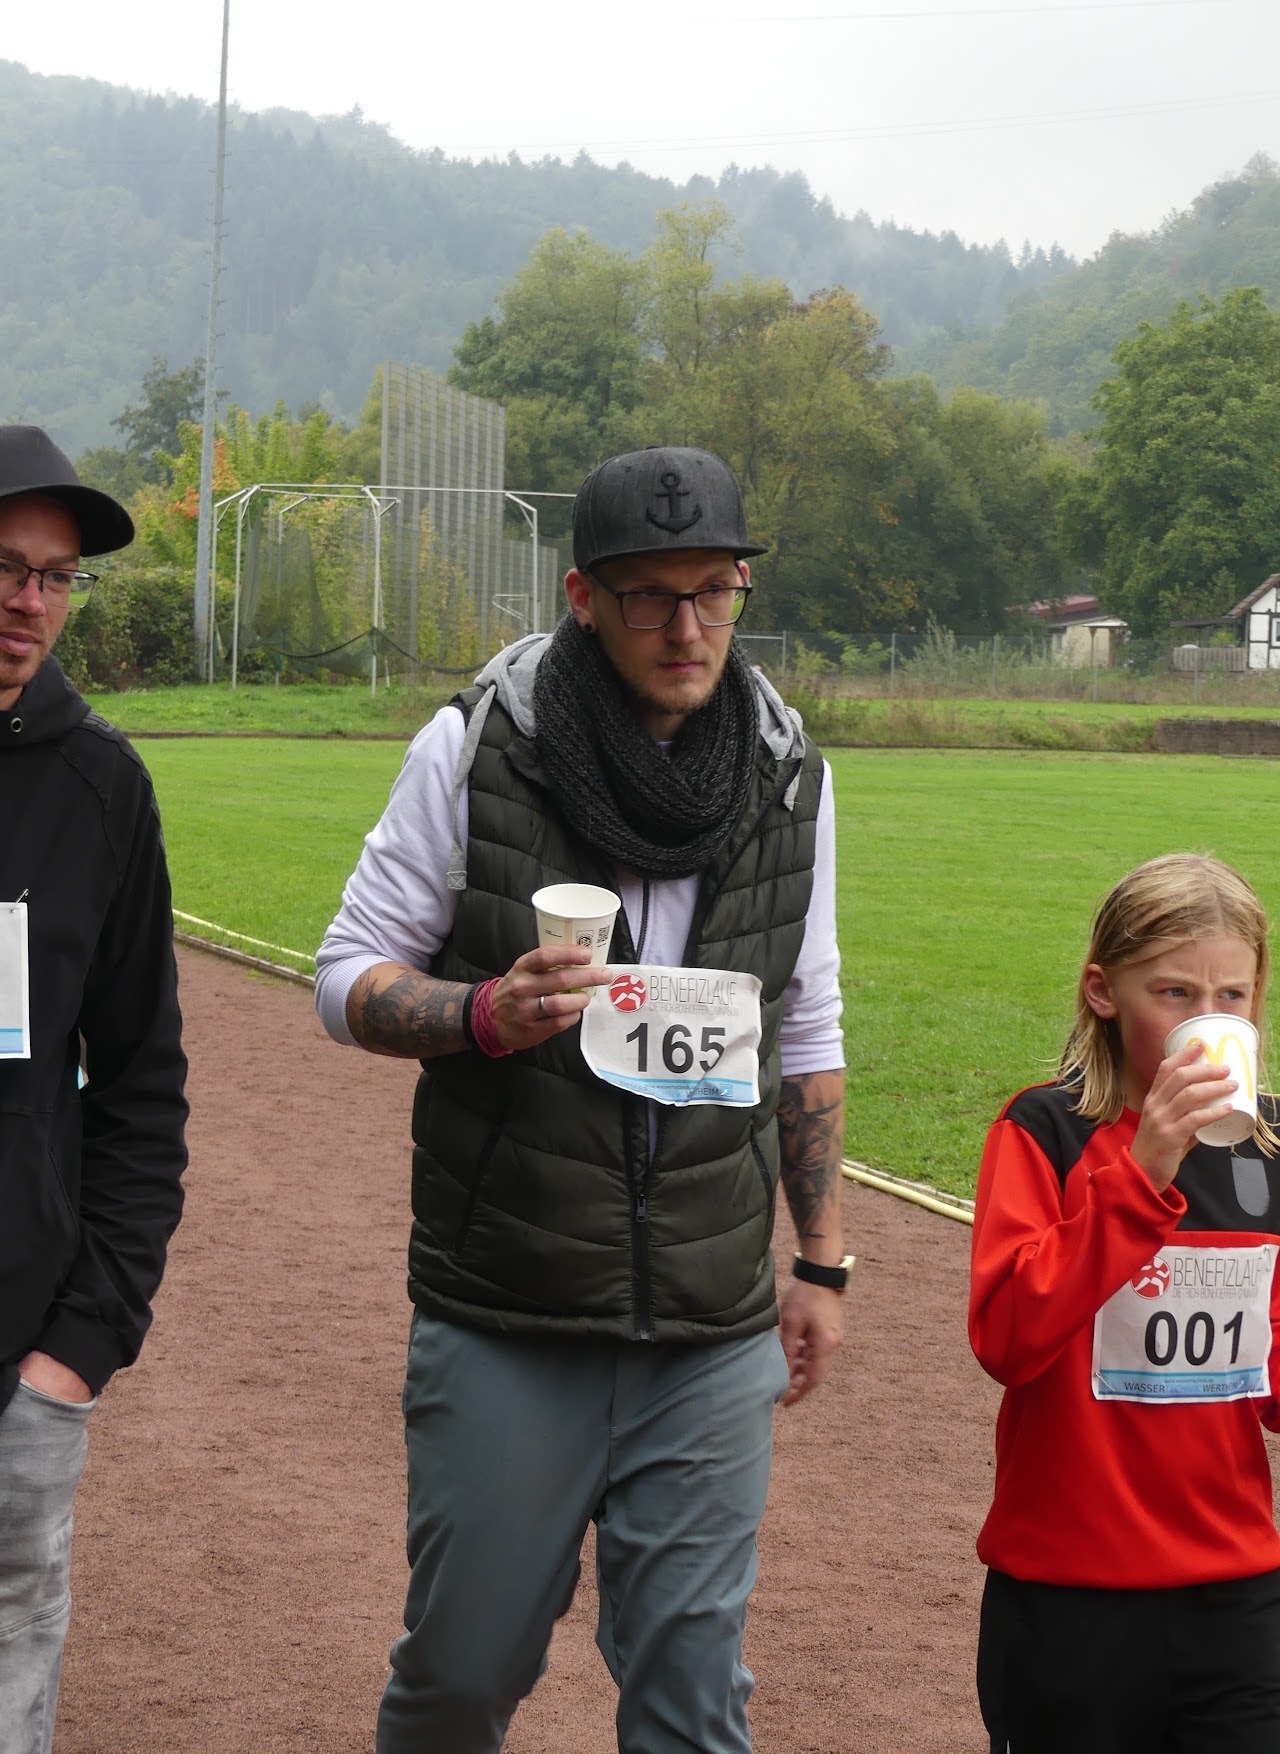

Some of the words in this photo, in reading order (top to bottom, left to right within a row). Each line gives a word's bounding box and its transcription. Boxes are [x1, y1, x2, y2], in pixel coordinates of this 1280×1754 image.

[650, 975, 737, 1005] BENEFIZLAUF
[625, 1022, 725, 1074] 165
[1144, 1310, 1244, 1367] 001
